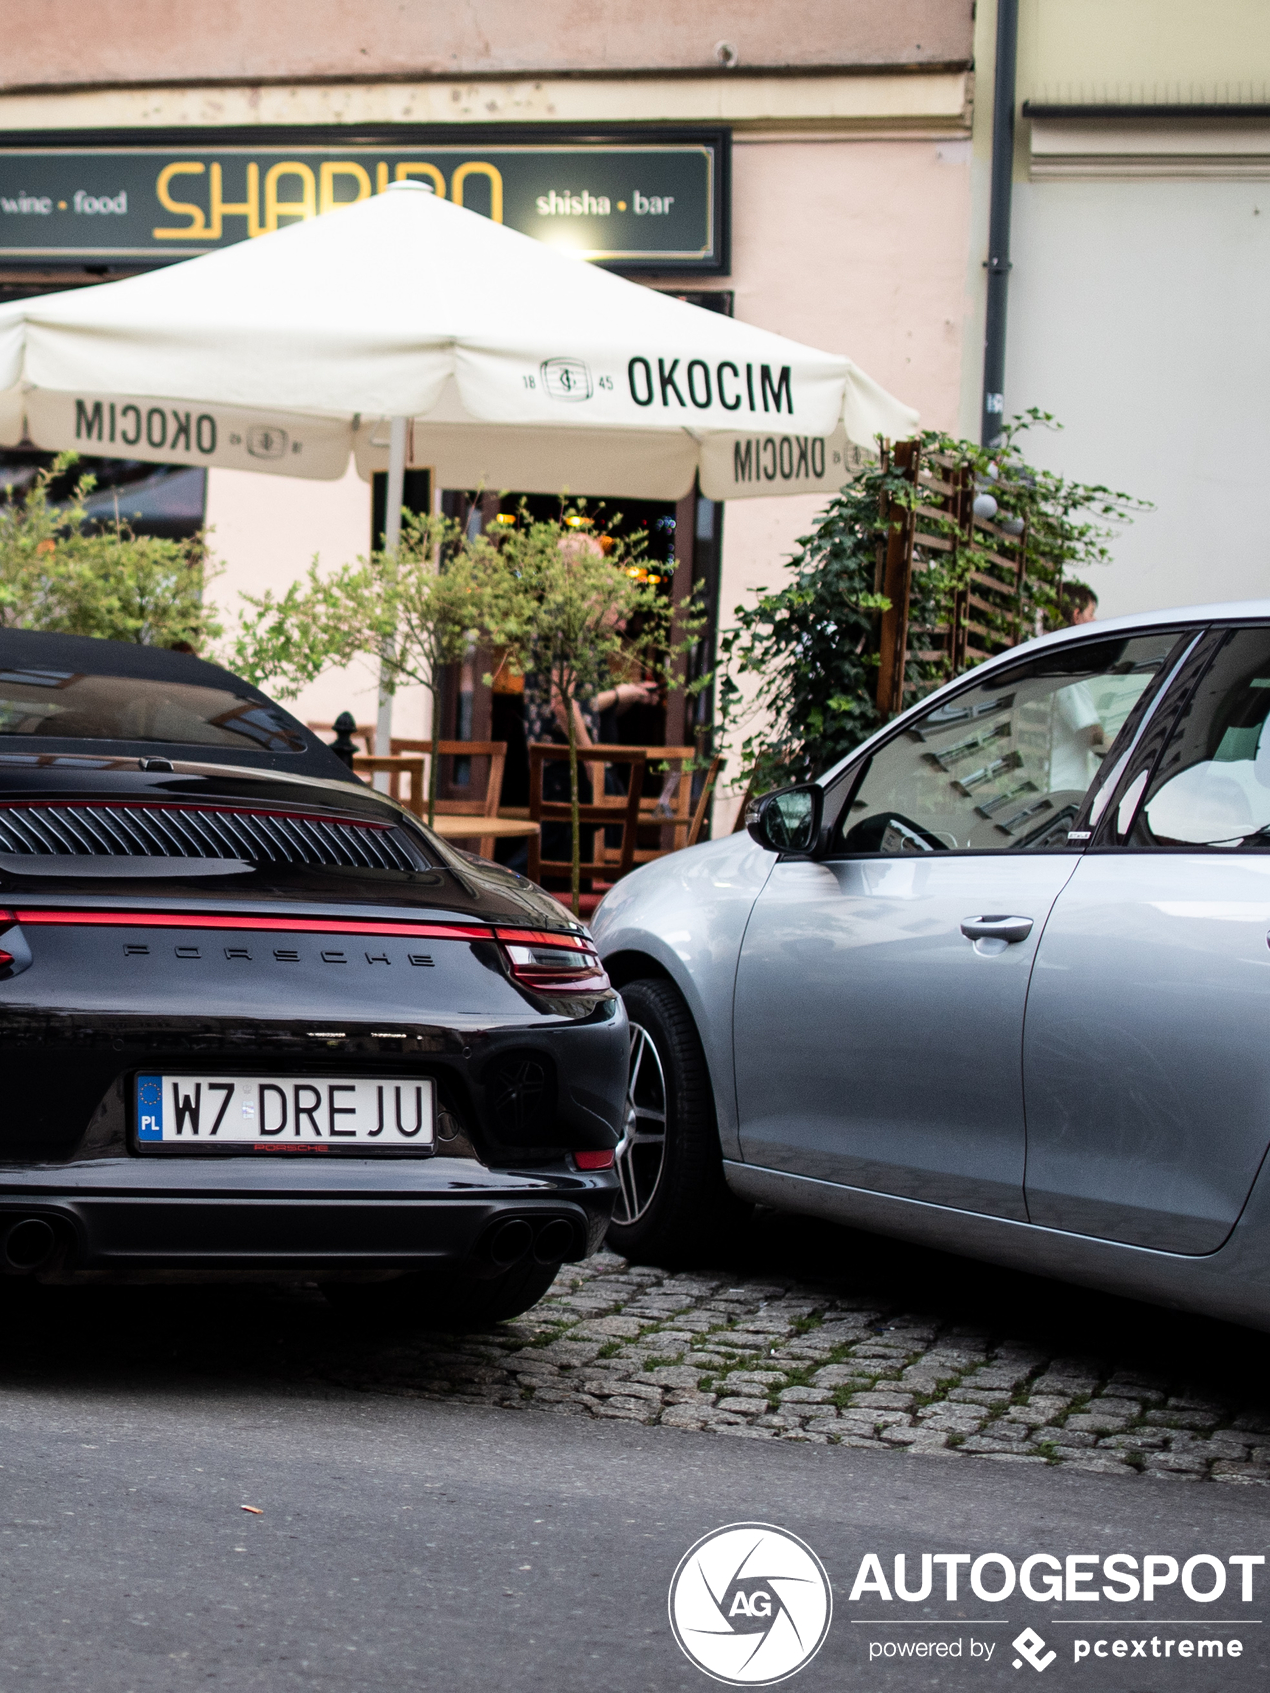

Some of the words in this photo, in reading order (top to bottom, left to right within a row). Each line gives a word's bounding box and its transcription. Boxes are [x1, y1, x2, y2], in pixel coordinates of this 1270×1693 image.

[0, 190, 52, 215] wine
[74, 189, 128, 215] food
[536, 190, 611, 216] shisha
[633, 190, 675, 215] bar
[523, 374, 536, 389] 18
[598, 374, 614, 390] 45
[628, 357, 794, 414] OKOCIM
[122, 943, 436, 967] PORSCHE
[171, 1081, 235, 1136] W7
[258, 1082, 423, 1137] DREJU
[141, 1115, 160, 1131] PL
[253, 1143, 329, 1152] PORSCHE
